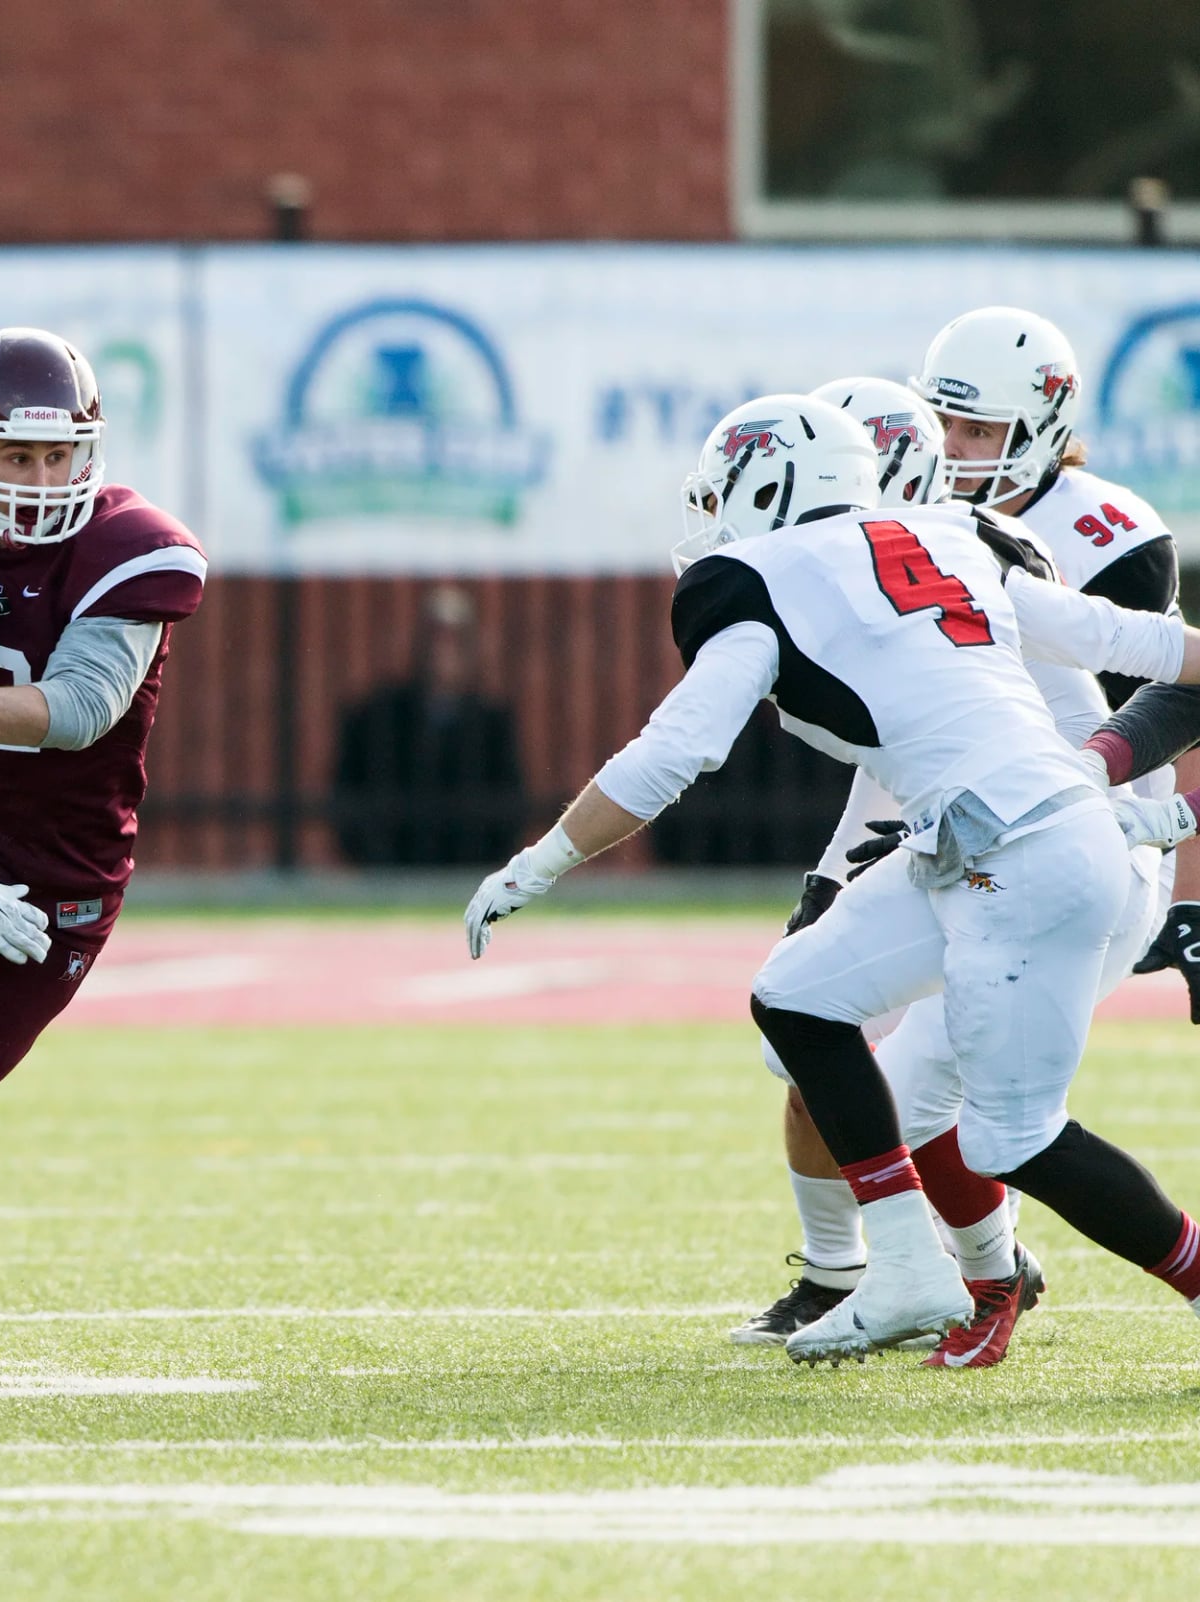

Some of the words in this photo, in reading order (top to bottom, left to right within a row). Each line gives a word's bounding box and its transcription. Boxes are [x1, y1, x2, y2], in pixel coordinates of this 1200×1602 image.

[940, 380, 969, 395] Riddell
[24, 410, 58, 420] Riddell
[1074, 503, 1138, 547] 94
[860, 520, 995, 647] 4
[86, 904, 92, 913] L
